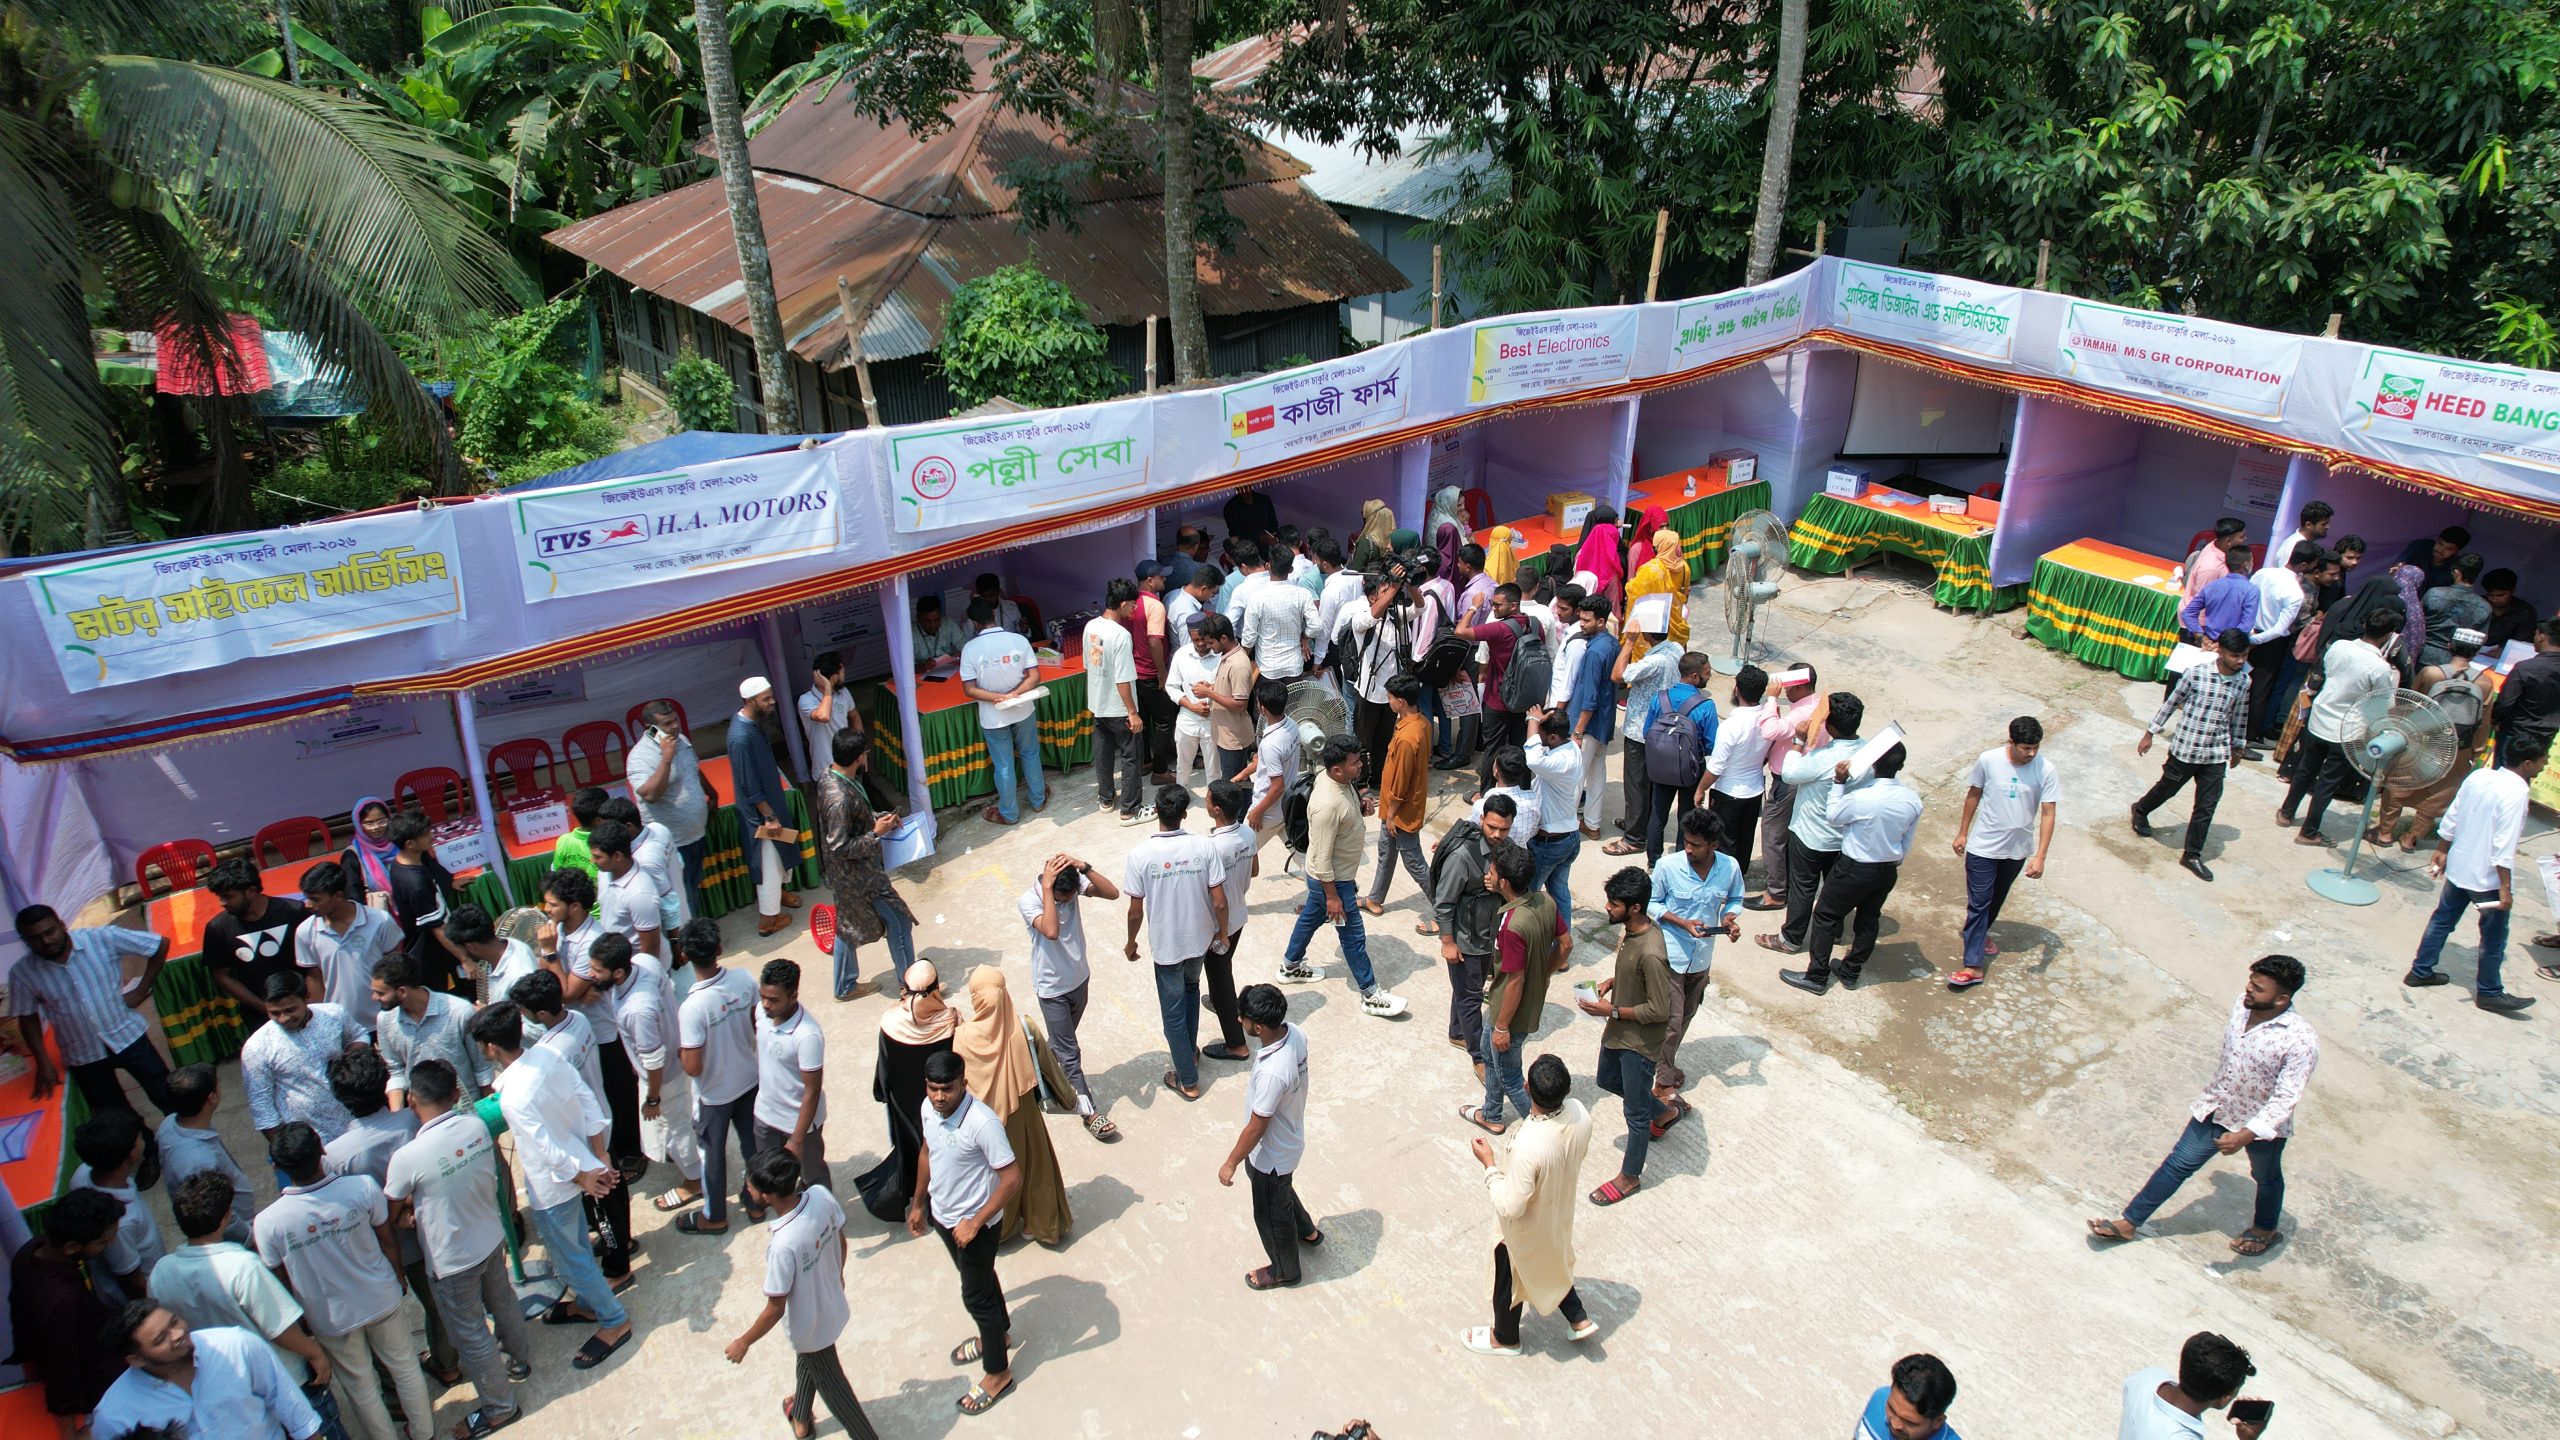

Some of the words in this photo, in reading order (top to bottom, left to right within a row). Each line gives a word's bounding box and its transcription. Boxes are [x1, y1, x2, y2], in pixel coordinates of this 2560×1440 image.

[1881, 287, 1920, 318] ডিজাইন
[1740, 307, 1768, 330] পাইপ
[2122, 315, 2164, 332] জিজেইউএস
[2166, 324, 2188, 338] চাকুরি
[1499, 341, 1532, 360] Best
[1536, 333, 1610, 355] Electronics
[2082, 336, 2117, 354] YAMAHA
[2123, 346, 2147, 359] M/S
[2151, 351, 2171, 364] GR
[2174, 356, 2282, 386] CORPORATION
[2438, 366, 2498, 385] জিজেইউএস
[2499, 375, 2530, 393] চাকুরি
[1272, 379, 1310, 395] জিজেইউএস
[1278, 387, 1344, 426] কাজী
[1351, 367, 1401, 406] ফার্ম
[2424, 391, 2487, 418] HEED
[2492, 402, 2560, 431] BANG
[963, 431, 1014, 447] জিজেইউএস
[1017, 426, 1041, 441] চাকুরি
[1043, 421, 1091, 436] মেলা-২০২৬
[2412, 427, 2459, 443] আলতাজের
[2460, 434, 2489, 448] রহমান
[965, 445, 1043, 487] পল্লী
[1057, 435, 1137, 475] সেবা
[602, 485, 664, 505] জিজেইউএস
[667, 479, 696, 497] চাকুরি
[699, 472, 759, 491] মেলা-২০২৬
[655, 514, 708, 536] H.A.
[716, 489, 828, 527] MOTORS
[540, 528, 591, 553] TVS
[153, 549, 234, 577] জিজেইউএস
[239, 543, 277, 565] চাকুরি
[282, 536, 358, 558] মেলা-২০২৬
[632, 560, 652, 573] সদর
[654, 557, 678, 571] রোড,
[679, 552, 704, 565] উকিল
[729, 545, 752, 558] ভোলা
[67, 594, 160, 642] মটর
[161, 571, 310, 624] সাইকেল
[310, 545, 448, 598] সার্ভিসিং
[528, 828, 541, 837] CV
[543, 823, 562, 834] BOX
[450, 858, 463, 868] CV
[465, 852, 485, 864] BOX
